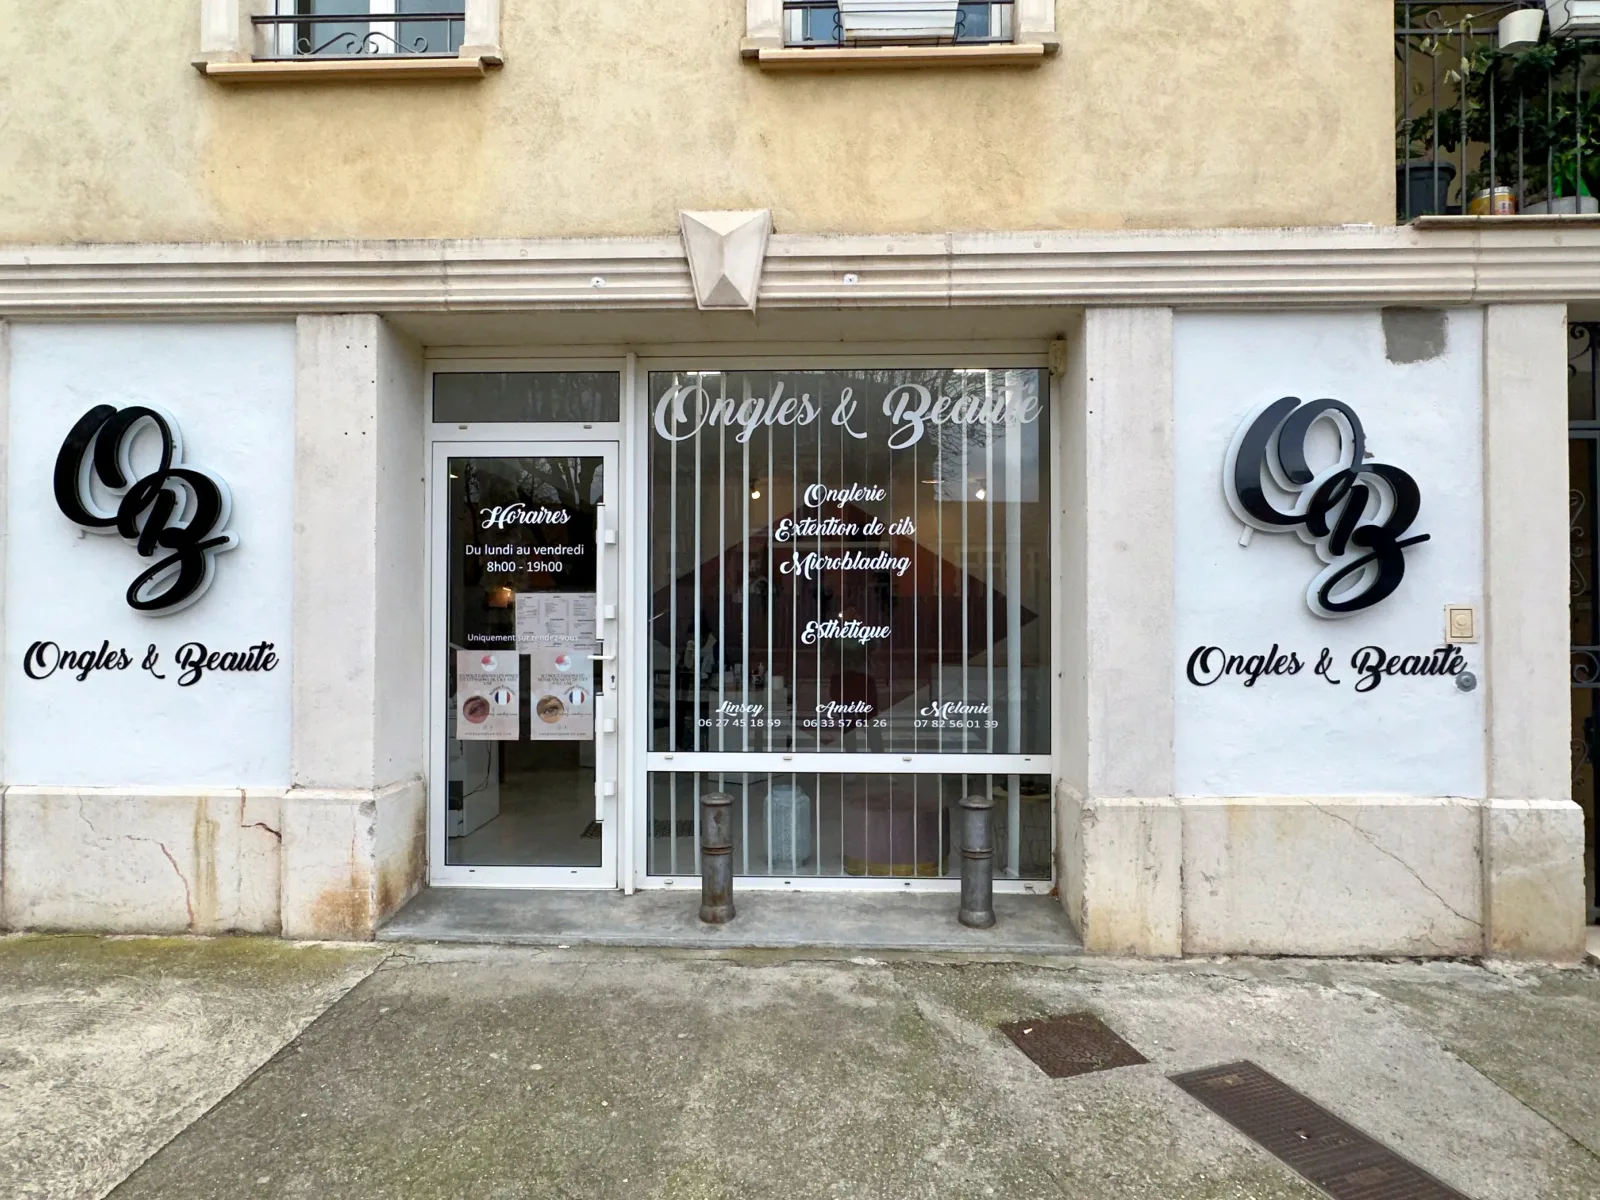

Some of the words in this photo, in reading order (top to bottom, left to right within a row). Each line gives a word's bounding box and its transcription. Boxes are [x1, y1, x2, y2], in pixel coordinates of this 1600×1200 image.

[654, 381, 821, 443] Ongles
[831, 386, 867, 439] &
[882, 380, 1044, 449] Beauté
[804, 482, 887, 509] Onglerie
[480, 502, 571, 529] Horaires
[775, 516, 860, 542] Extention
[862, 516, 885, 536] de
[888, 516, 917, 536] cils
[465, 545, 482, 555] Du
[484, 544, 513, 555] lundi
[516, 546, 531, 555] au
[533, 544, 585, 555] vendredi
[486, 561, 516, 572] 8h00
[526, 561, 563, 572] 19h00
[779, 551, 912, 580] Microblading
[467, 634, 516, 642] Uniquement
[532, 634, 579, 642] rendez-vous
[801, 619, 892, 645] Esthétique
[23, 640, 133, 681] Ongles
[141, 643, 166, 680] &
[175, 641, 280, 687] Beauté
[1186, 643, 1305, 687] Ongles
[1314, 647, 1341, 684] &
[1351, 643, 1468, 693] Beauté
[715, 700, 765, 717] Linsey
[815, 700, 874, 719] Amélie
[920, 701, 993, 720] Mélanie
[698, 719, 713, 727] 06
[715, 719, 729, 727] 27
[732, 719, 745, 727] 45
[750, 719, 764, 727] 18
[767, 719, 781, 727] 59
[803, 719, 818, 728] 06
[820, 719, 835, 728] 33
[838, 719, 852, 728] 57
[855, 719, 869, 728] 61
[872, 719, 887, 728] 26
[913, 719, 928, 728] 07
[931, 719, 943, 728] 82
[949, 719, 963, 728] 56
[966, 719, 981, 728] 01
[984, 719, 999, 728] 39
